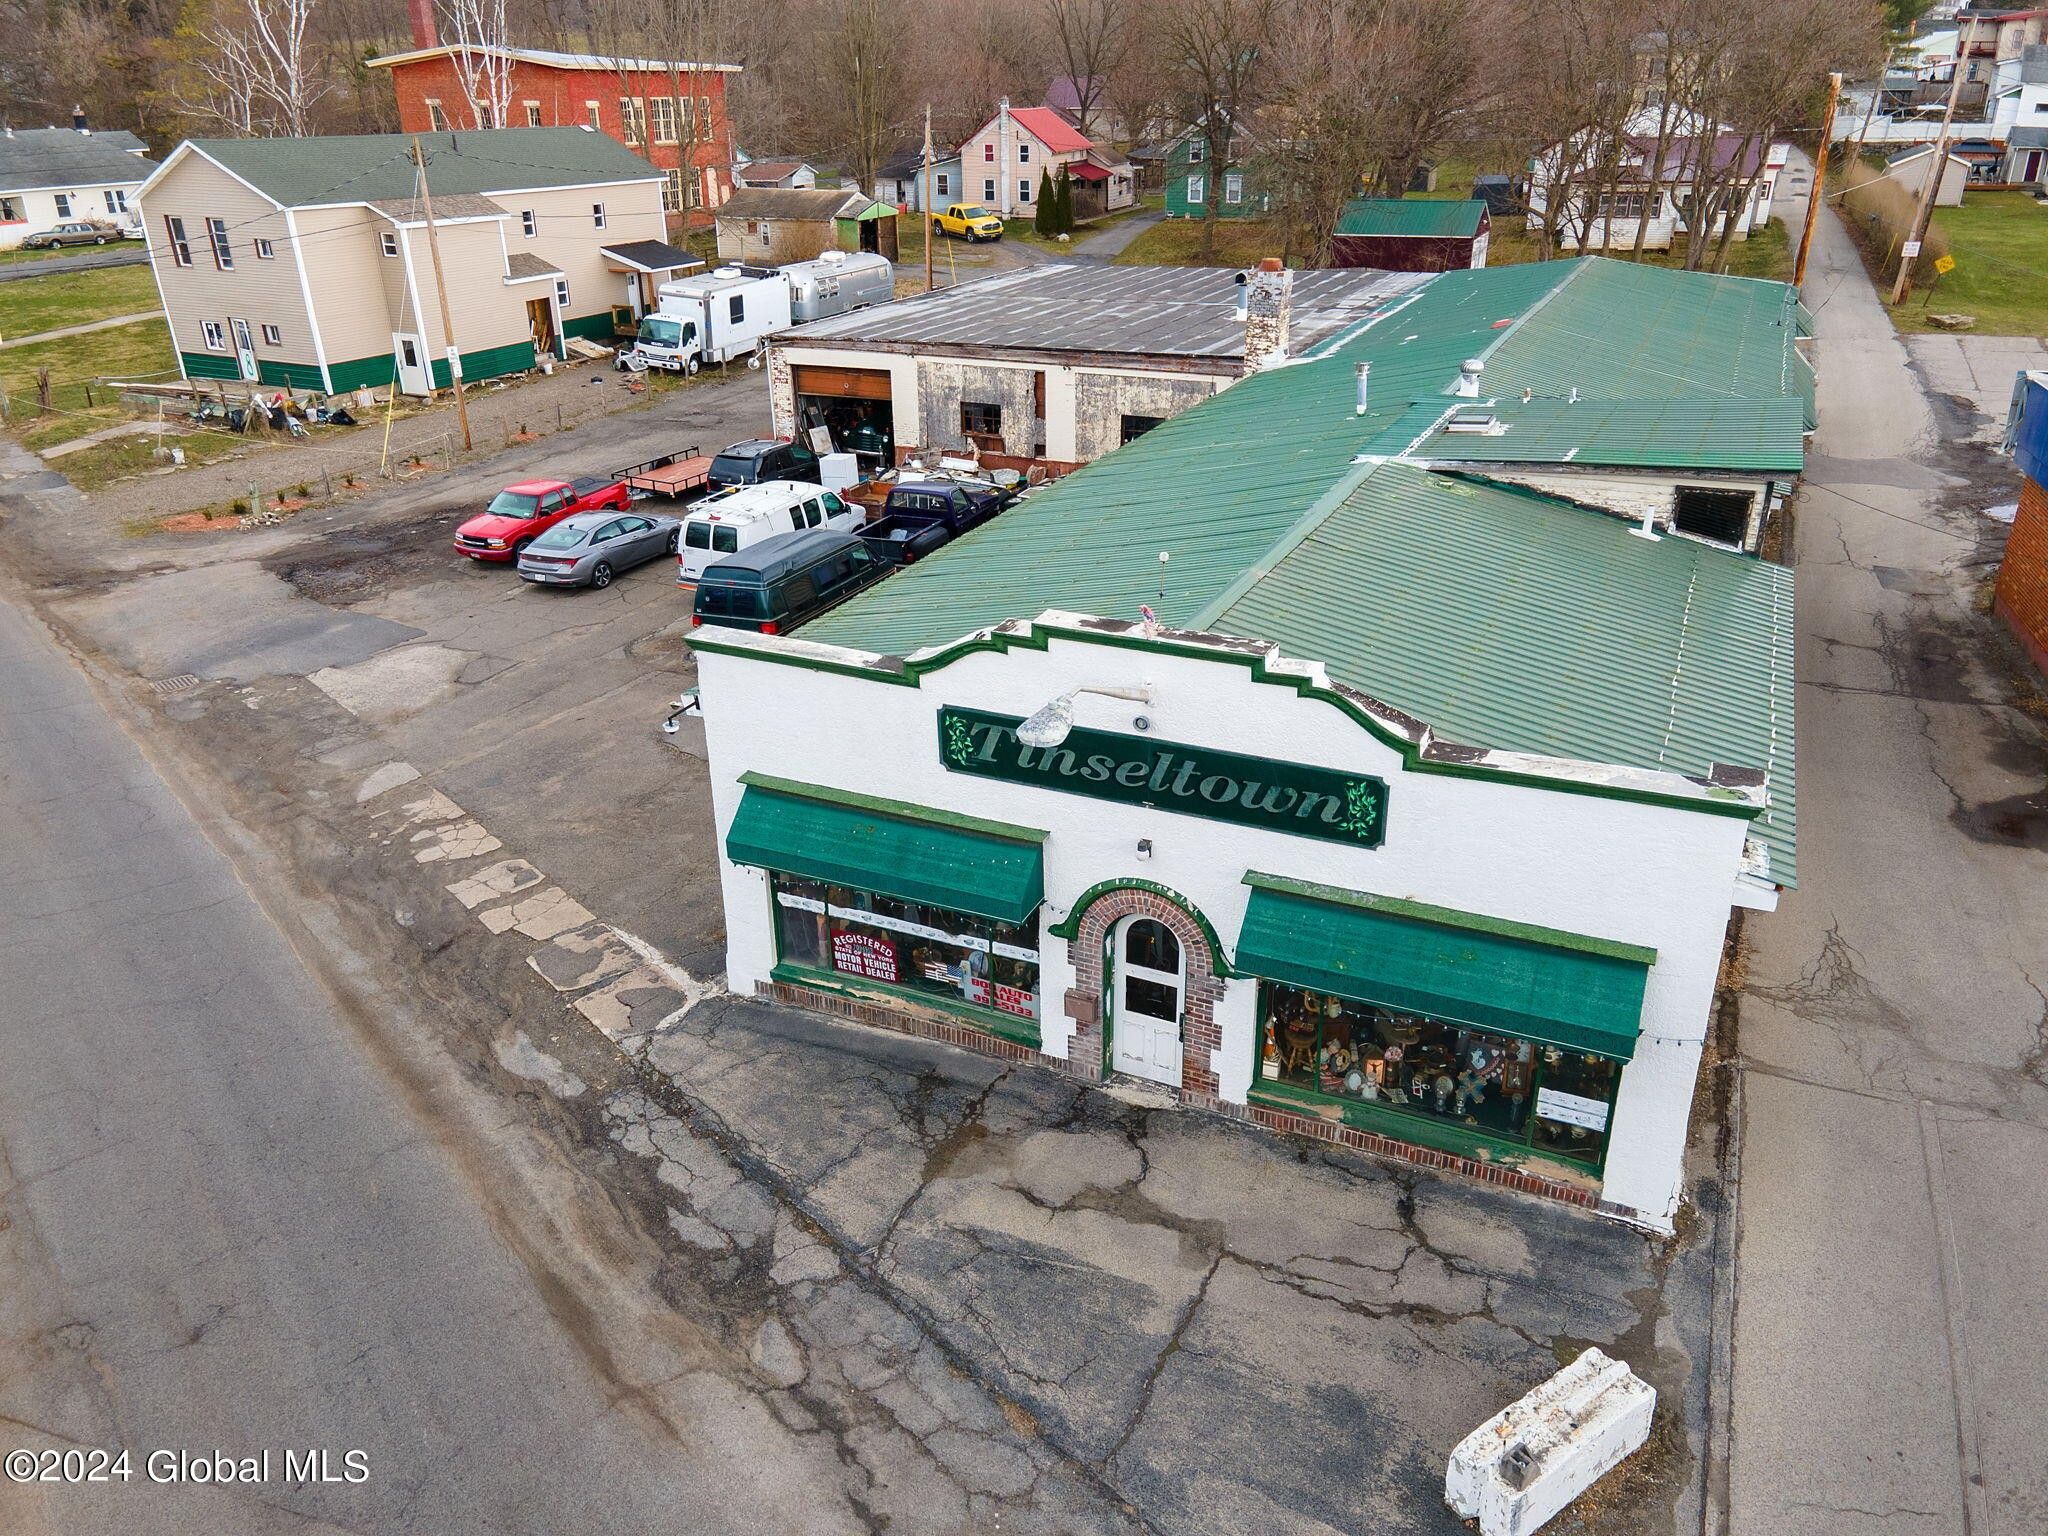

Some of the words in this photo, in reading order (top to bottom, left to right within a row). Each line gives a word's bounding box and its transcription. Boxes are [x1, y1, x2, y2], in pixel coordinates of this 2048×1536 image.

[970, 722, 1344, 824] Tinseltown
[833, 934, 893, 957] REGISTERED
[834, 945, 853, 954] STATE
[863, 952, 876, 960] NEW
[877, 954, 894, 963] YORK
[834, 951, 862, 965] MOTOR
[863, 958, 897, 973] VEHICLE
[837, 960, 865, 974] RETAIL
[865, 966, 896, 981] DEALER
[999, 986, 1033, 1002] AUTO
